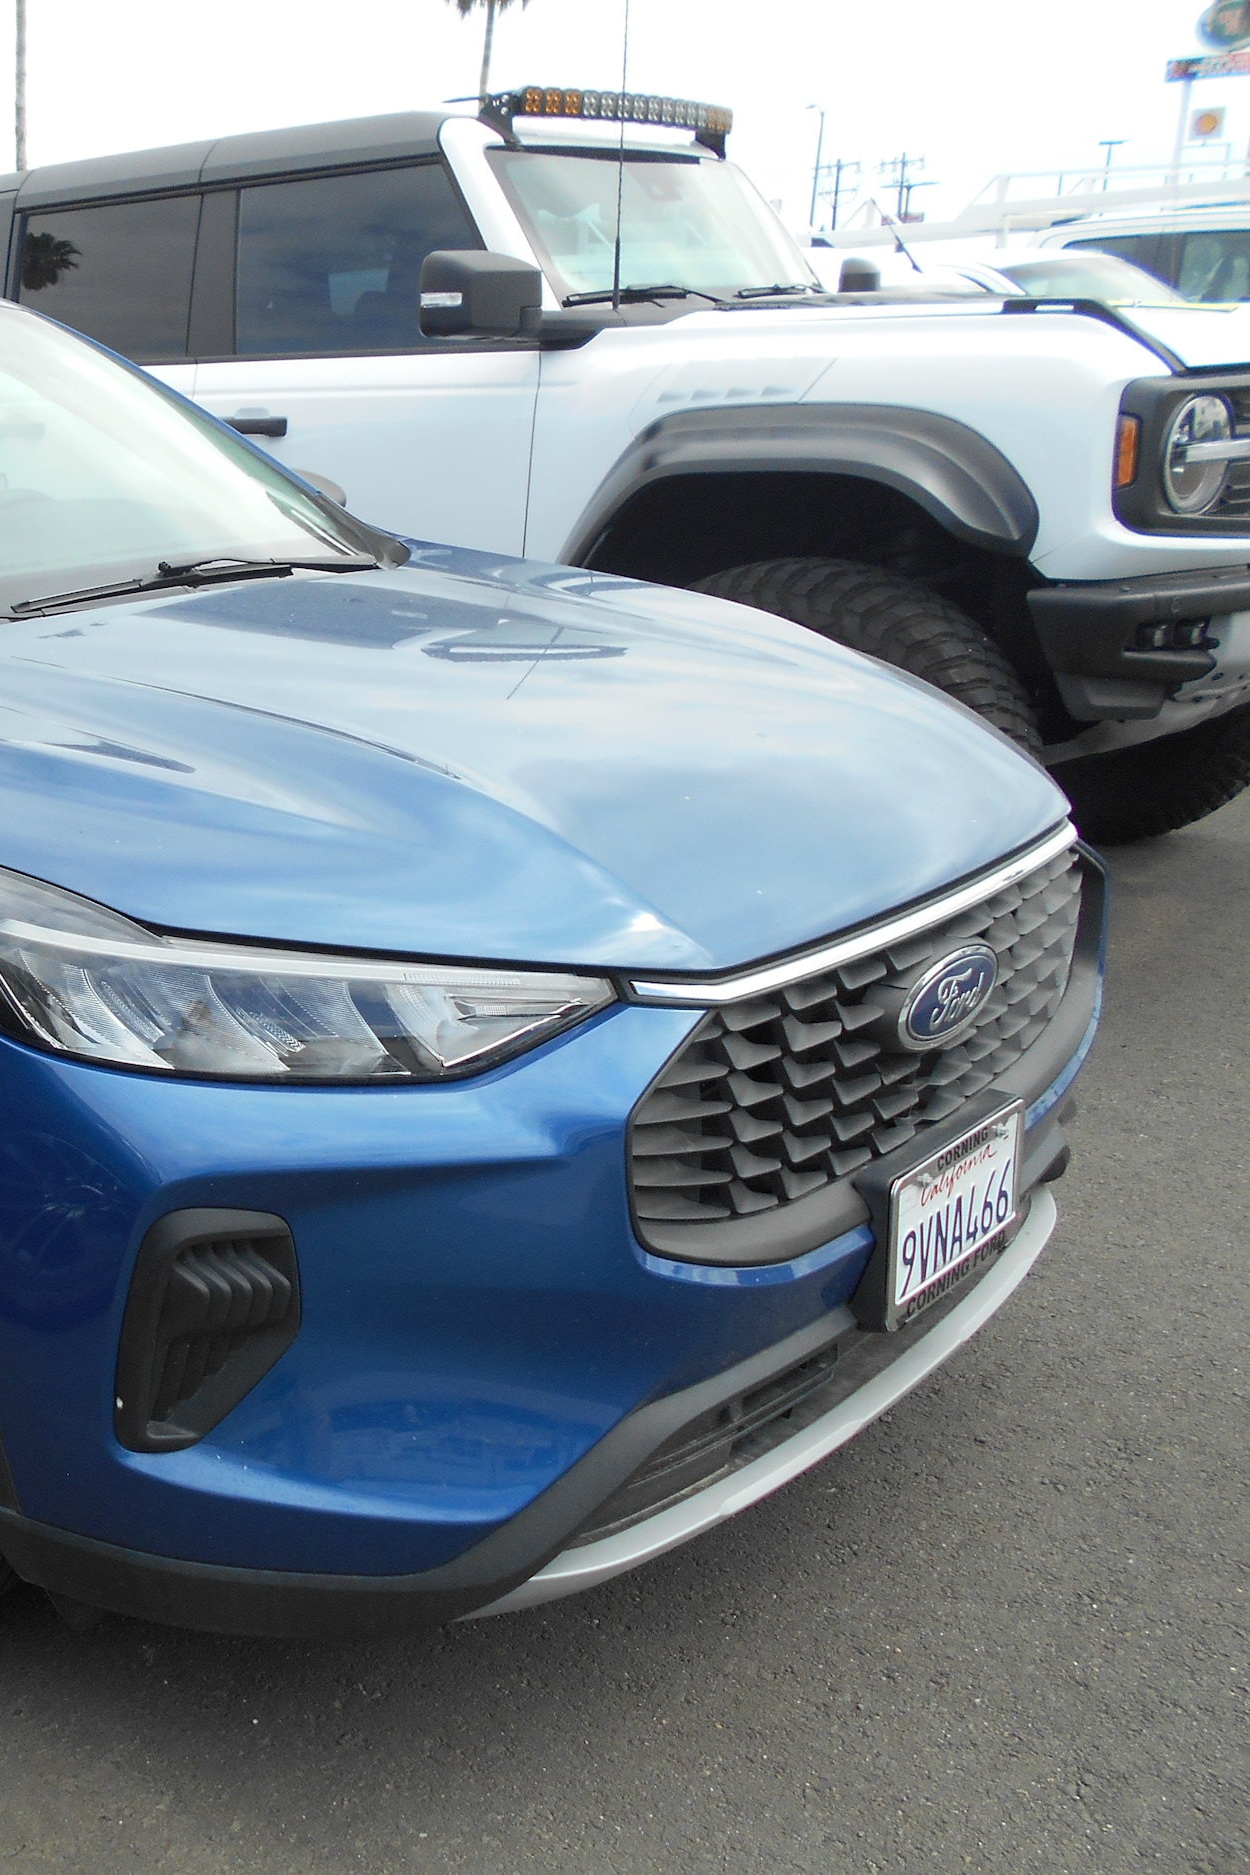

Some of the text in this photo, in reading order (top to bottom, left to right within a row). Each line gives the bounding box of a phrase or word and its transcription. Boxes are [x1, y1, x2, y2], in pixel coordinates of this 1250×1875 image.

[930, 967, 985, 1031] Ford
[921, 1144, 998, 1207] California
[937, 1127, 989, 1171] CORNING
[901, 1159, 1011, 1299] 9VNA466
[907, 1230, 1006, 1317] CORNING FORD
